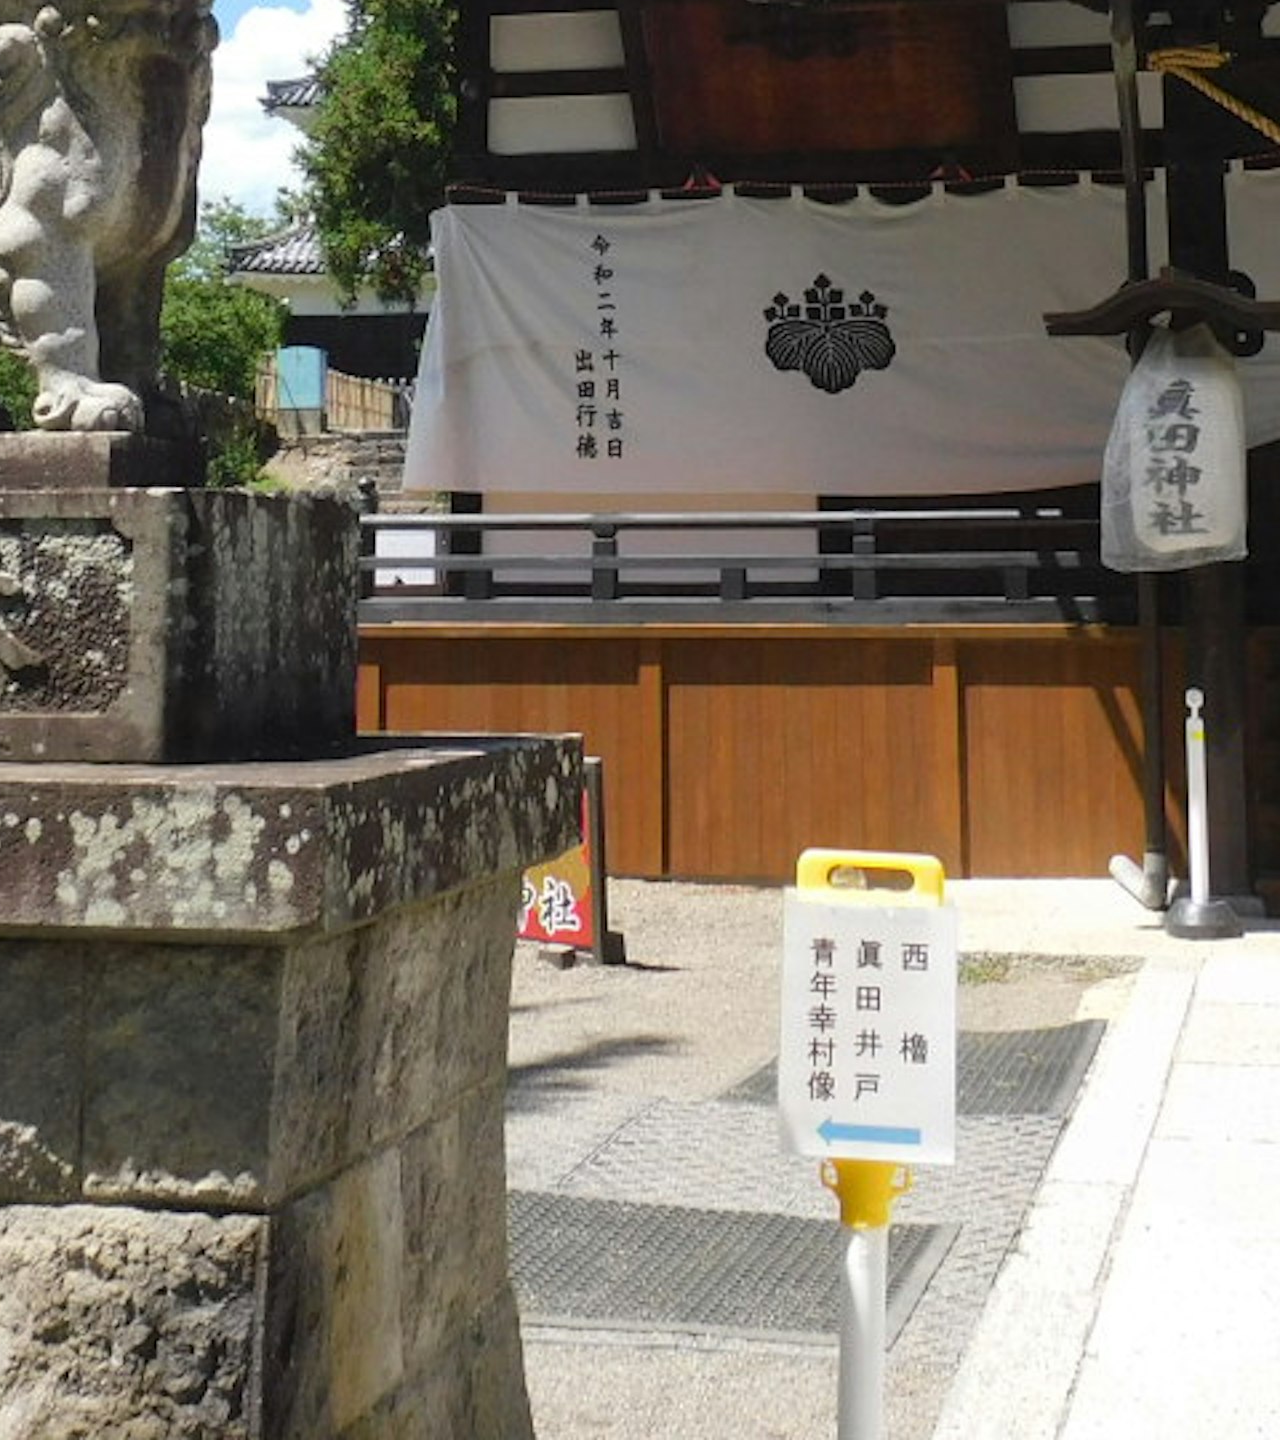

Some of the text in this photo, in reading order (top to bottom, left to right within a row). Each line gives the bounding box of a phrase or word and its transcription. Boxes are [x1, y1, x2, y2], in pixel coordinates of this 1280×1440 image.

[590, 234, 623, 458] 令和二年十月吉日
[807, 937, 838, 1102] 青年幸村像
[899, 942, 930, 1065] 西櫓
